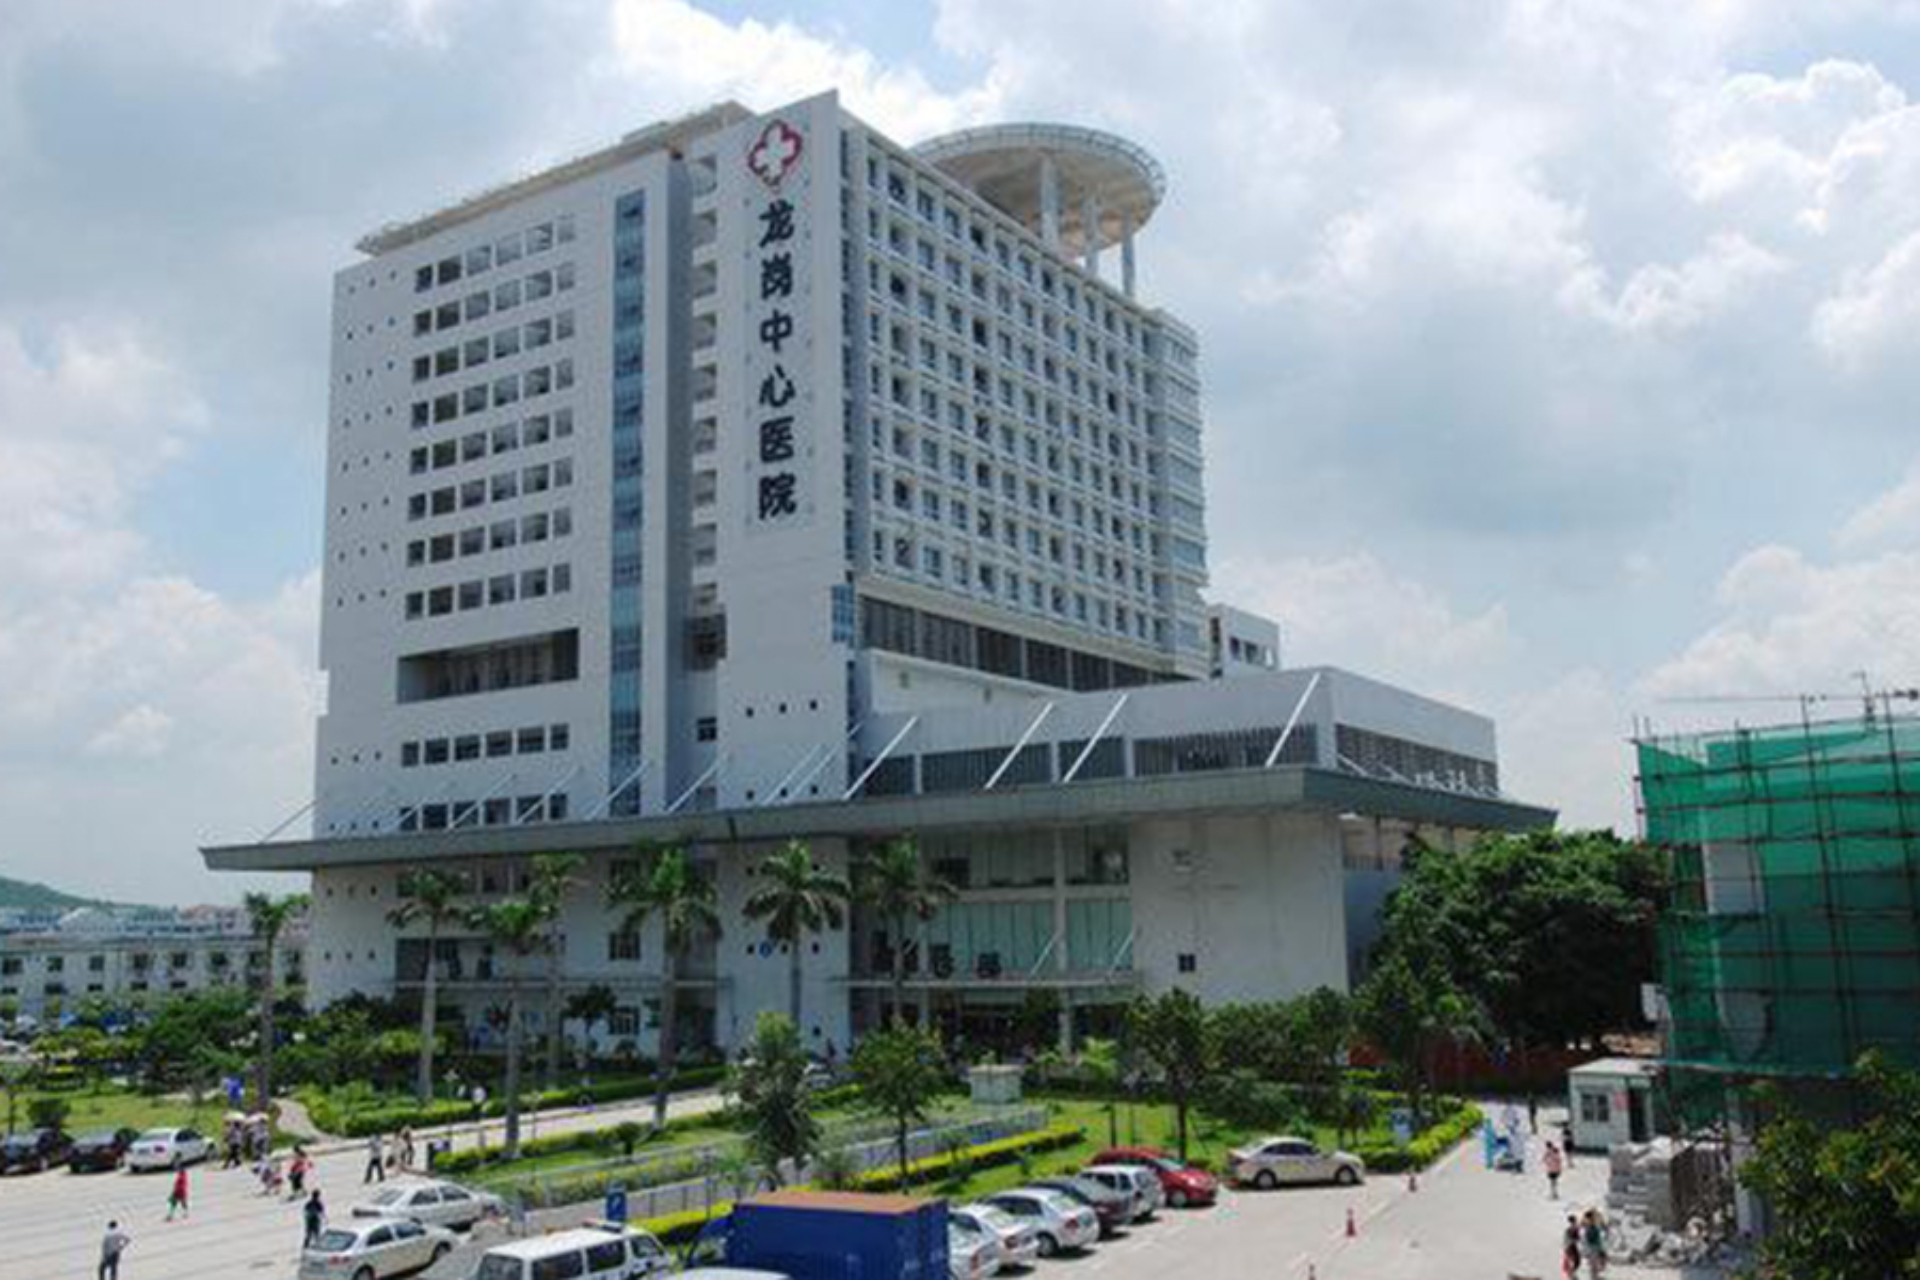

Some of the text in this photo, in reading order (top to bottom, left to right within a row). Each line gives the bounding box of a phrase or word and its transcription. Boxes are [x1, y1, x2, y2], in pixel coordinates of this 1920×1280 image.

[759, 199, 797, 520] 龙岗中心医院
